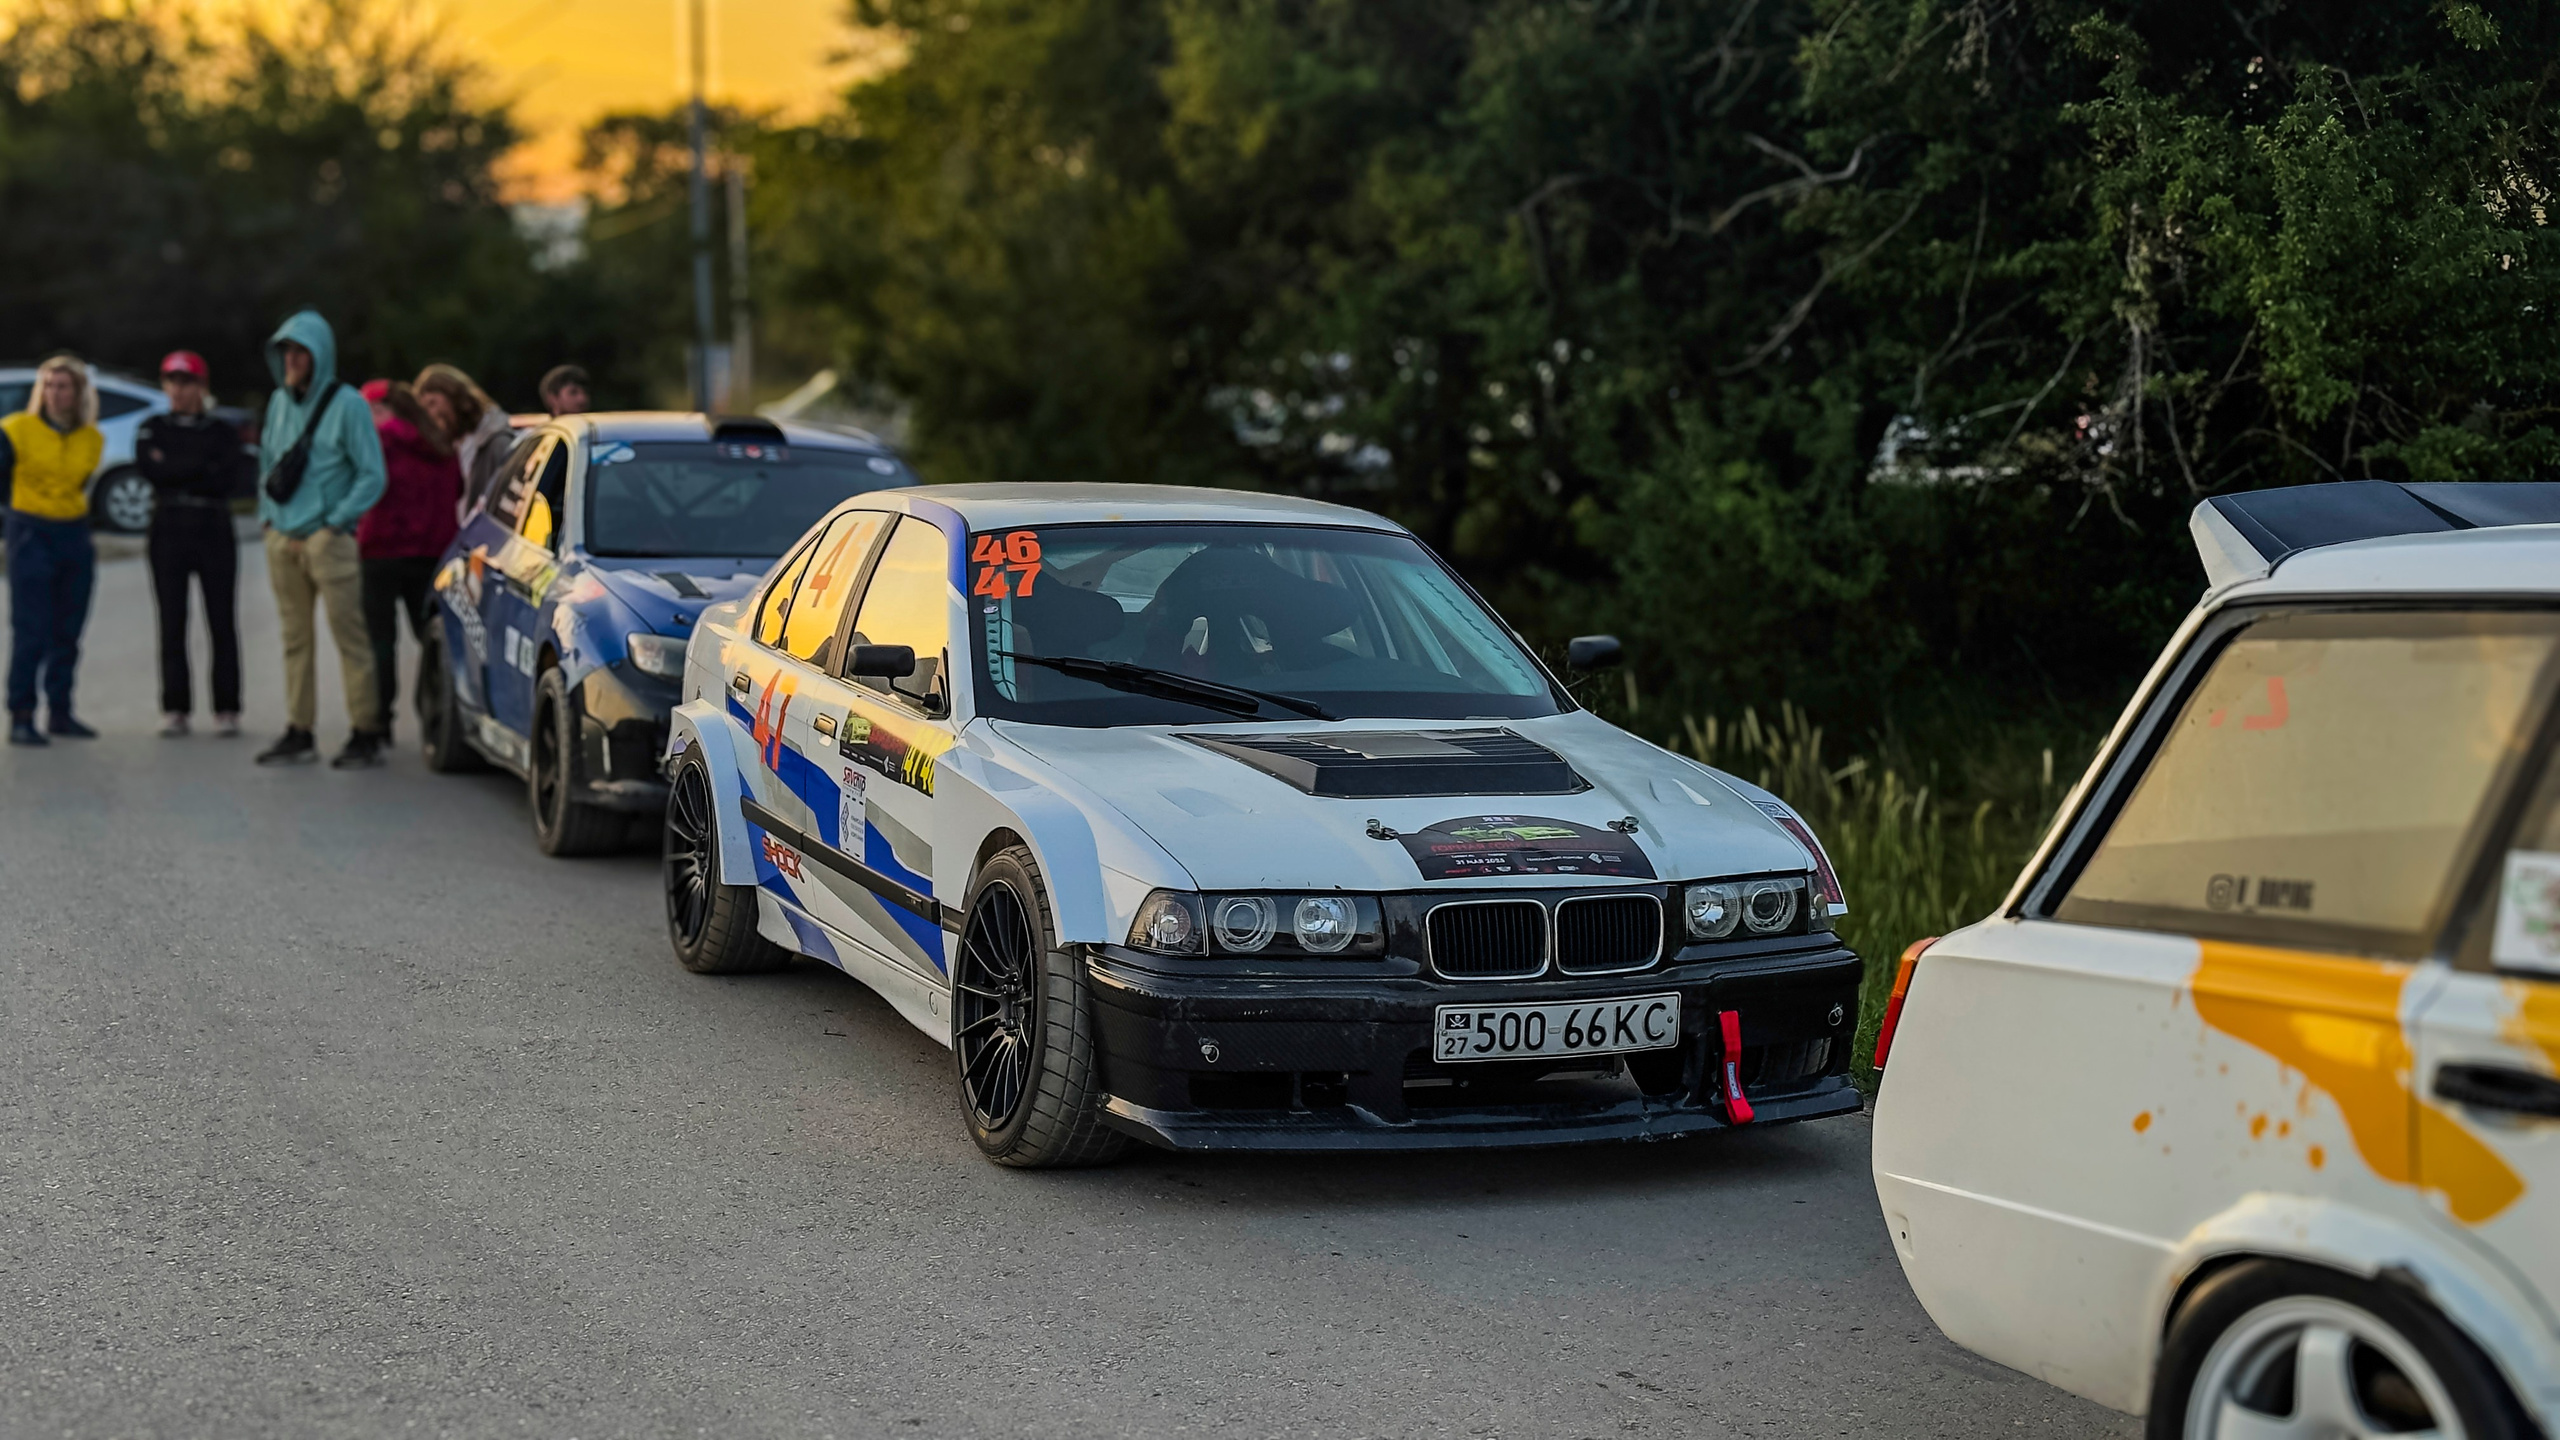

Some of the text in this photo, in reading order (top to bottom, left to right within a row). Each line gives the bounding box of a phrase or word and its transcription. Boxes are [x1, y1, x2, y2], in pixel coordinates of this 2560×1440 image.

[972, 531, 1041, 566] 46
[974, 563, 1042, 599] 47
[761, 834, 806, 884] SHOCK
[1444, 1036, 1468, 1055] 27
